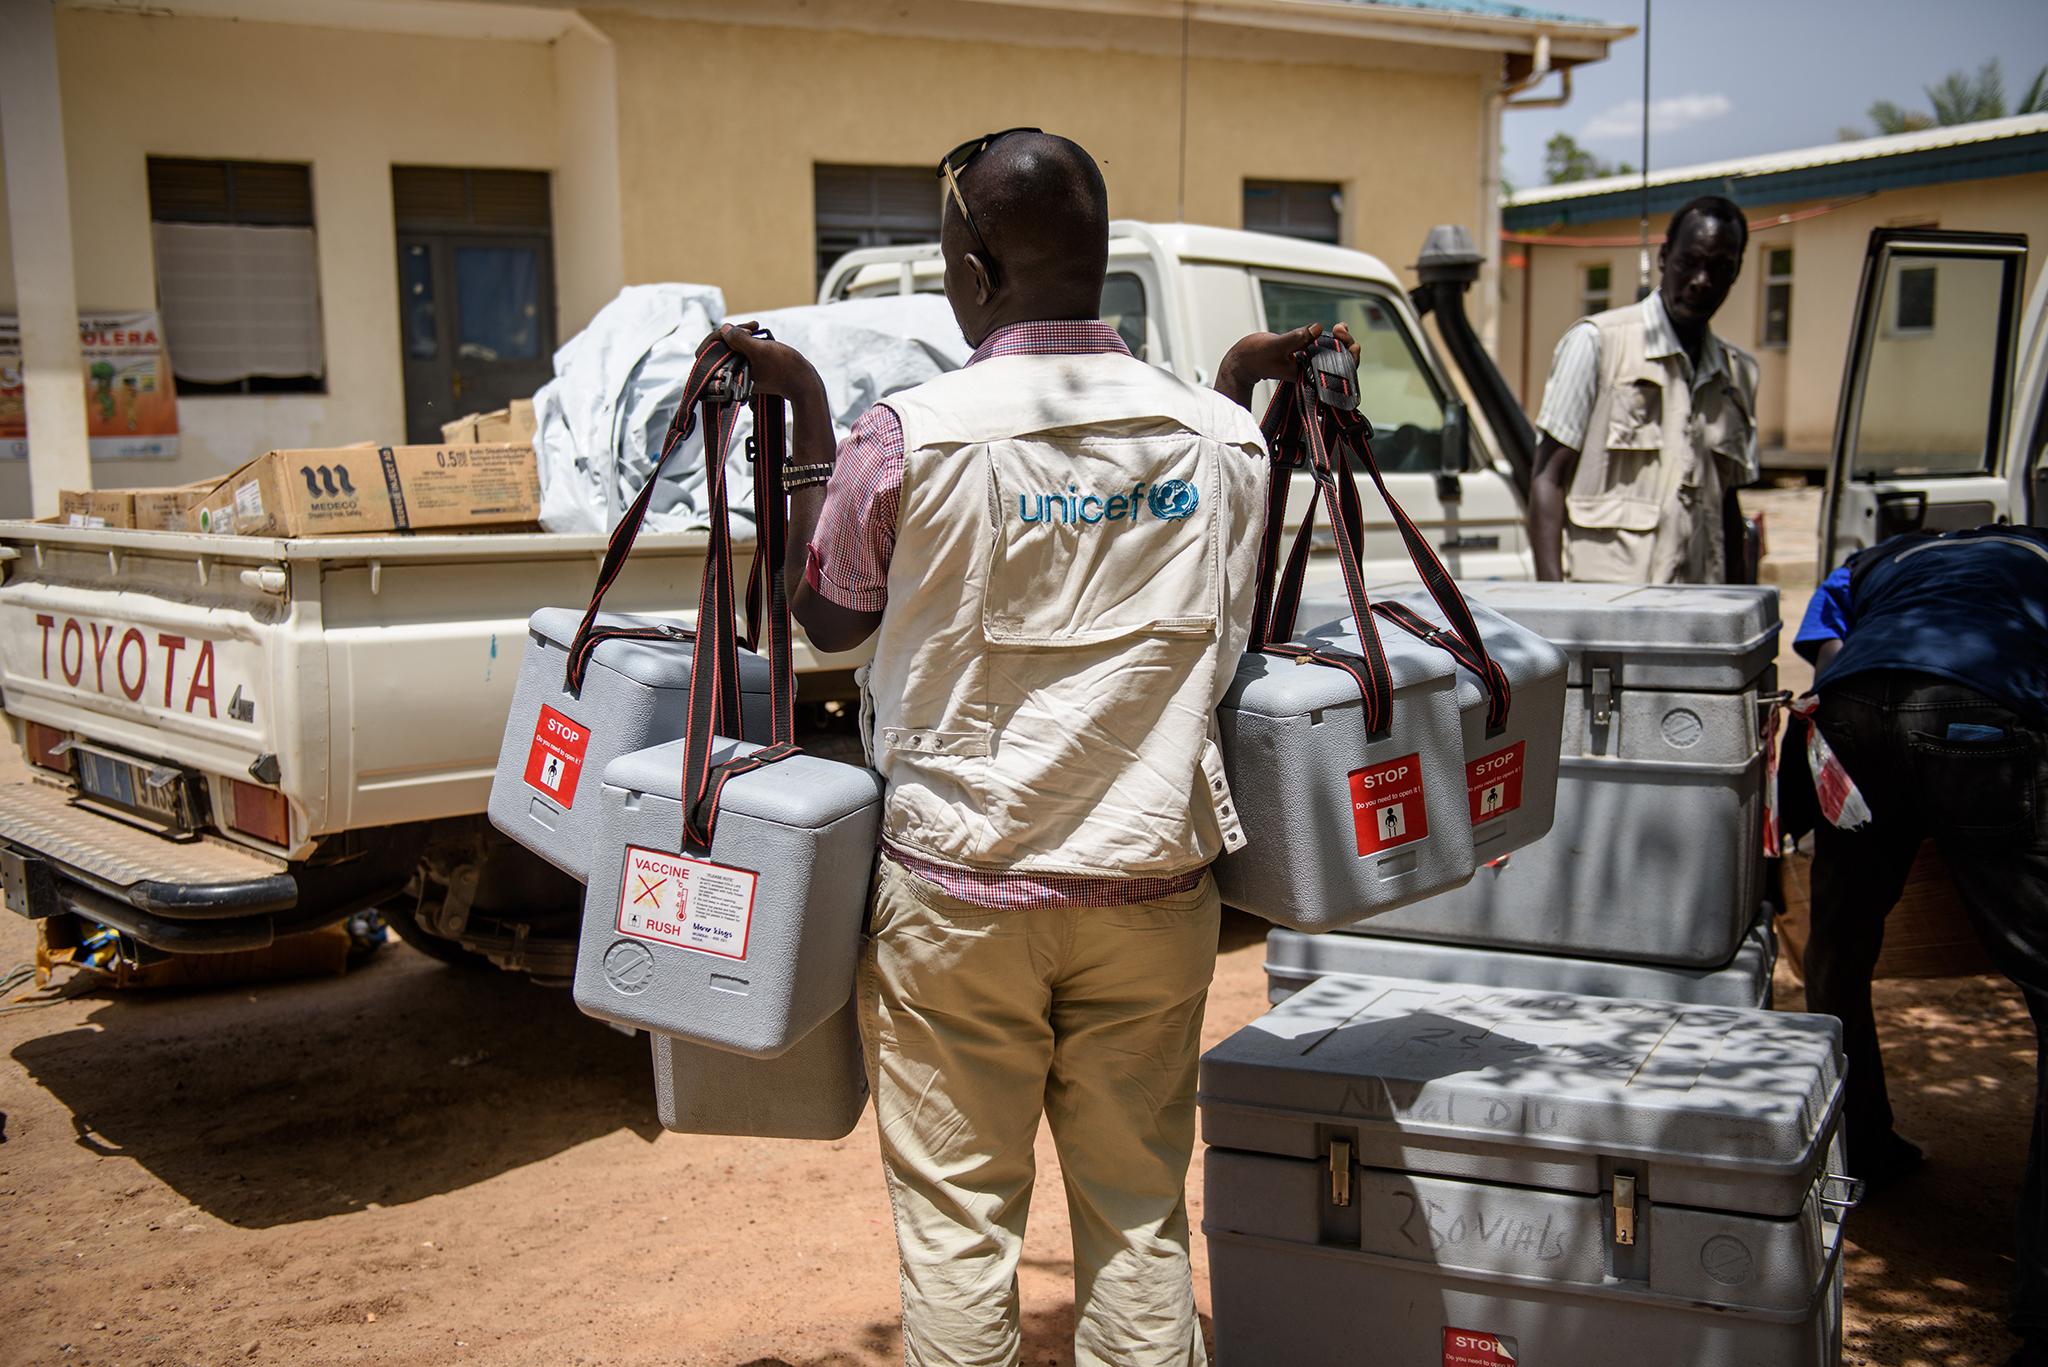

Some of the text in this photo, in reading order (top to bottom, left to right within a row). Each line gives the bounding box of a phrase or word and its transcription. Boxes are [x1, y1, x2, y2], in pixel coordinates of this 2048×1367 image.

[82, 330, 157, 346] OLERA
[311, 500, 357, 511] MEDECO
[1019, 482, 1146, 525] unicef
[36, 613, 217, 719] TOYOTA
[547, 718, 580, 743] STOP
[536, 734, 543, 743] Do
[550, 743, 561, 753] need
[564, 752, 575, 762] open
[1475, 752, 1514, 776] STOP
[1364, 766, 1408, 789] STOP
[1355, 802, 1365, 810] Do
[1365, 799, 1377, 809] you
[1377, 794, 1392, 804] need
[1398, 789, 1413, 798] open
[635, 858, 690, 880] VACCINE
[645, 919, 681, 937] RUSH
[1455, 1355, 1467, 1363] you
